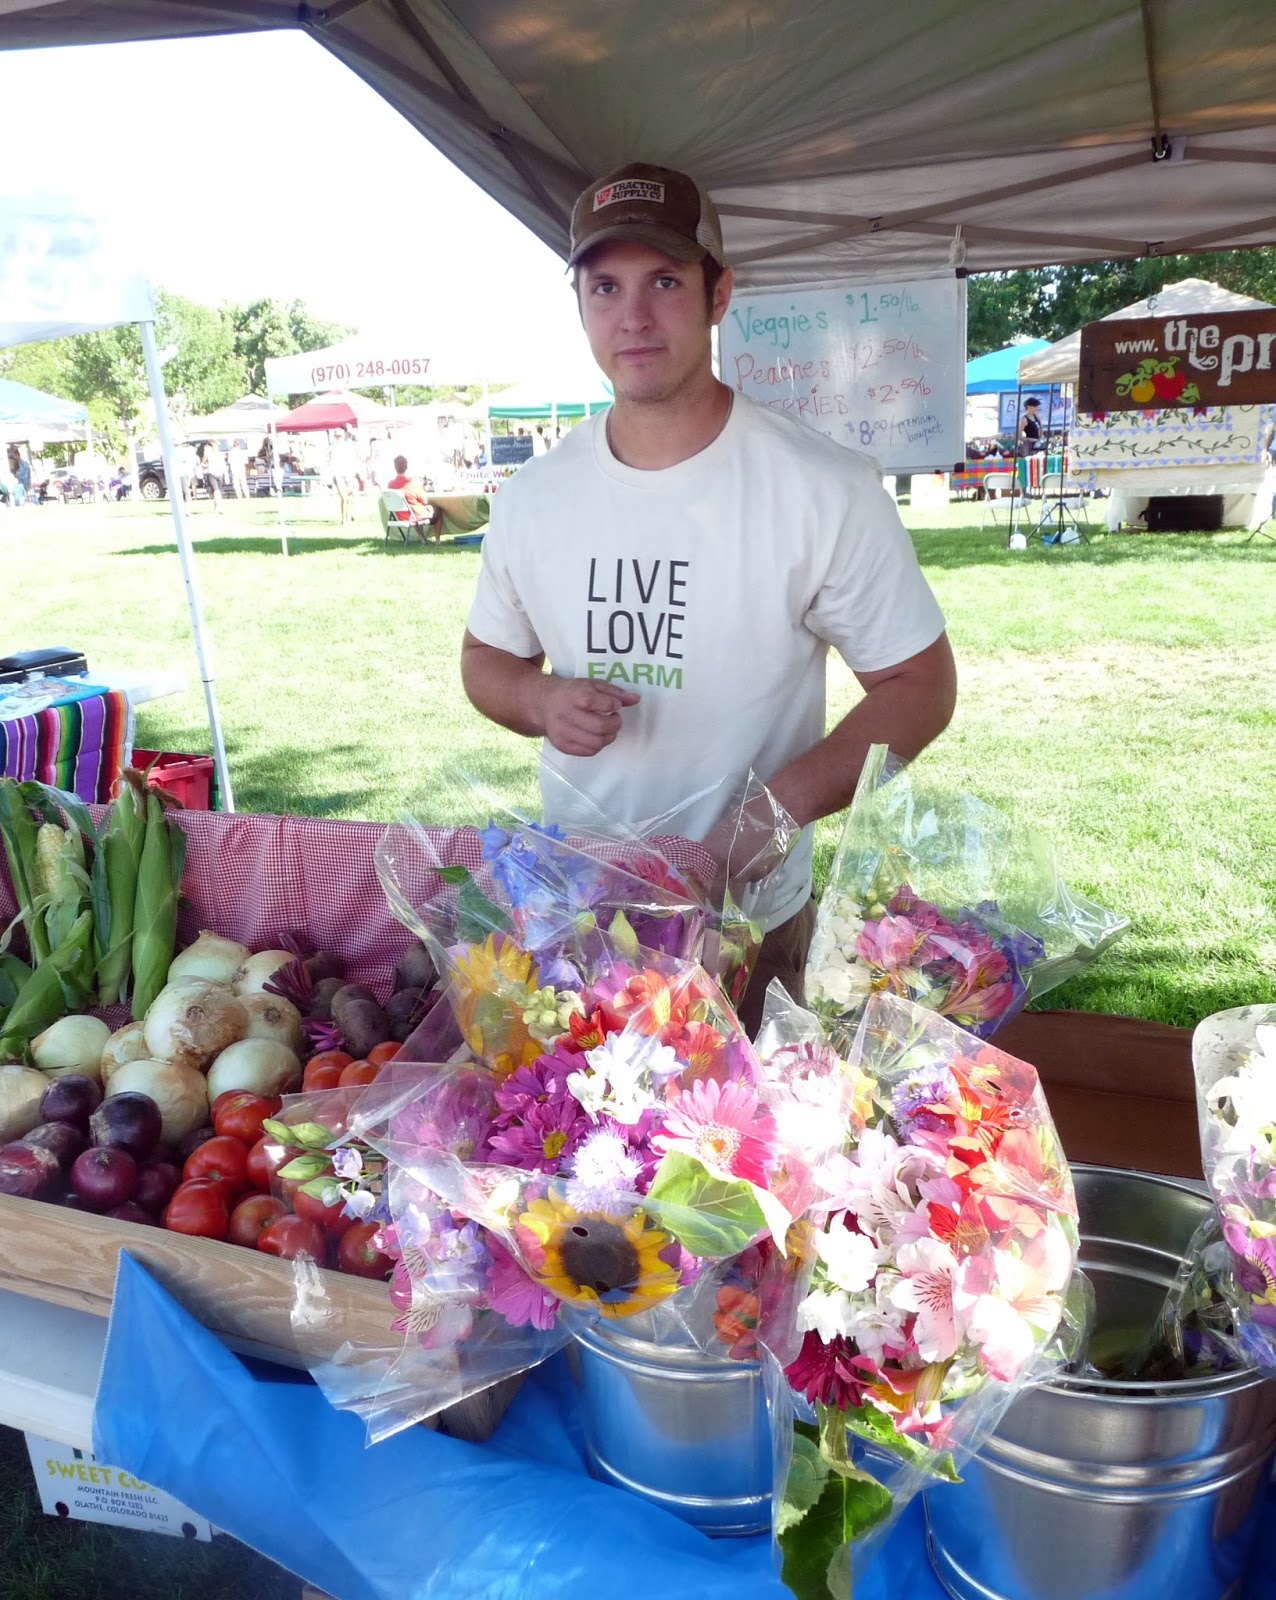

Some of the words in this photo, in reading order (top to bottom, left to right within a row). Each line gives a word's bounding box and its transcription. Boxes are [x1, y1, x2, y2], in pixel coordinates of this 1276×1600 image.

[611, 189, 649, 200] SUPPLY
[612, 181, 661, 192] TRACTOR
[731, 305, 829, 349] Veggies
[311, 362, 350, 386] (970)
[356, 358, 431, 379] 248-0057
[733, 352, 831, 391] Peaches
[588, 557, 689, 607] LIVE
[587, 609, 685, 660] LOVE
[587, 661, 683, 690] FARM
[46, 1458, 112, 1486] SWEET
[77, 1485, 120, 1498] MOUNTAIN
[120, 1491, 143, 1503] FRESH
[110, 1498, 127, 1507] BOX
[128, 1501, 144, 1510] 1282
[106, 1505, 148, 1519] COLORADO
[148, 1513, 169, 1522] 81425
